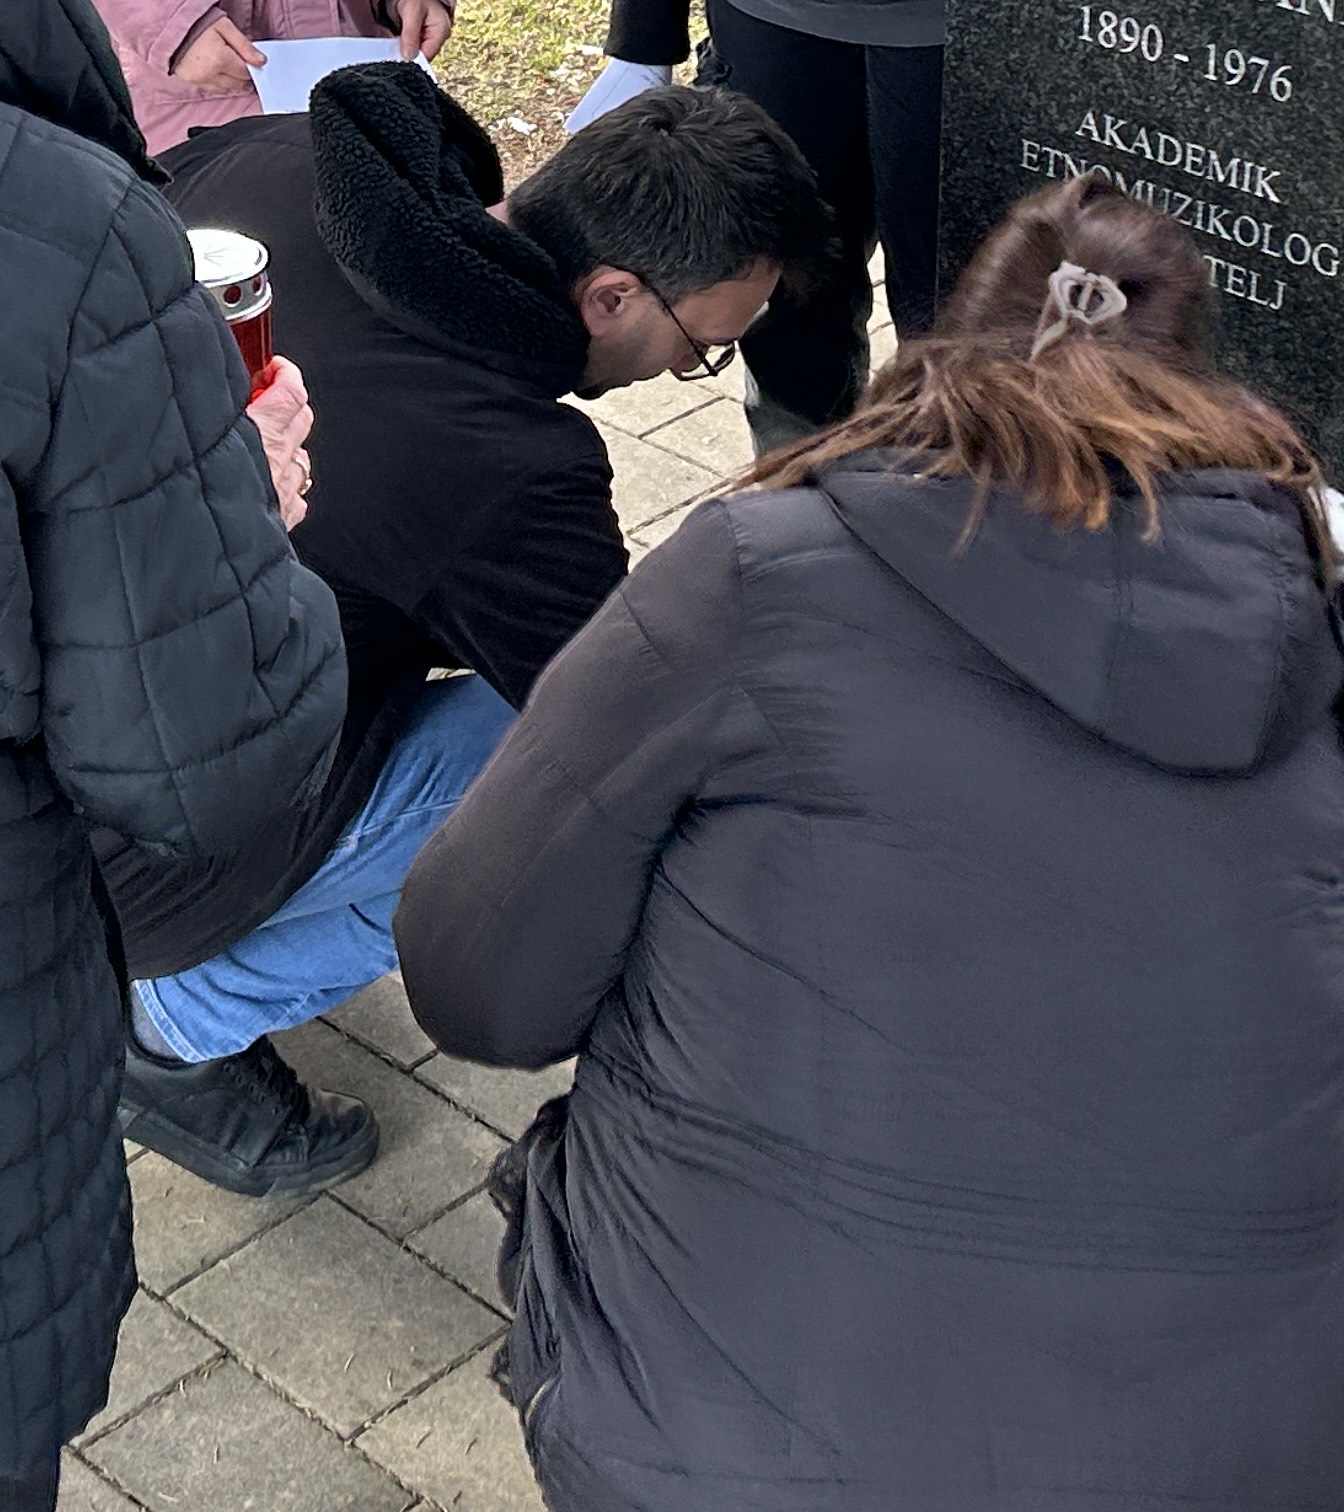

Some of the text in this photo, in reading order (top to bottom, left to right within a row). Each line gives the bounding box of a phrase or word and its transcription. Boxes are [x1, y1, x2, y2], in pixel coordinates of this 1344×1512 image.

[1078, 5, 1164, 63] 1890
[1203, 43, 1294, 104] 1976
[1075, 109, 1283, 204] AKADEMIK
